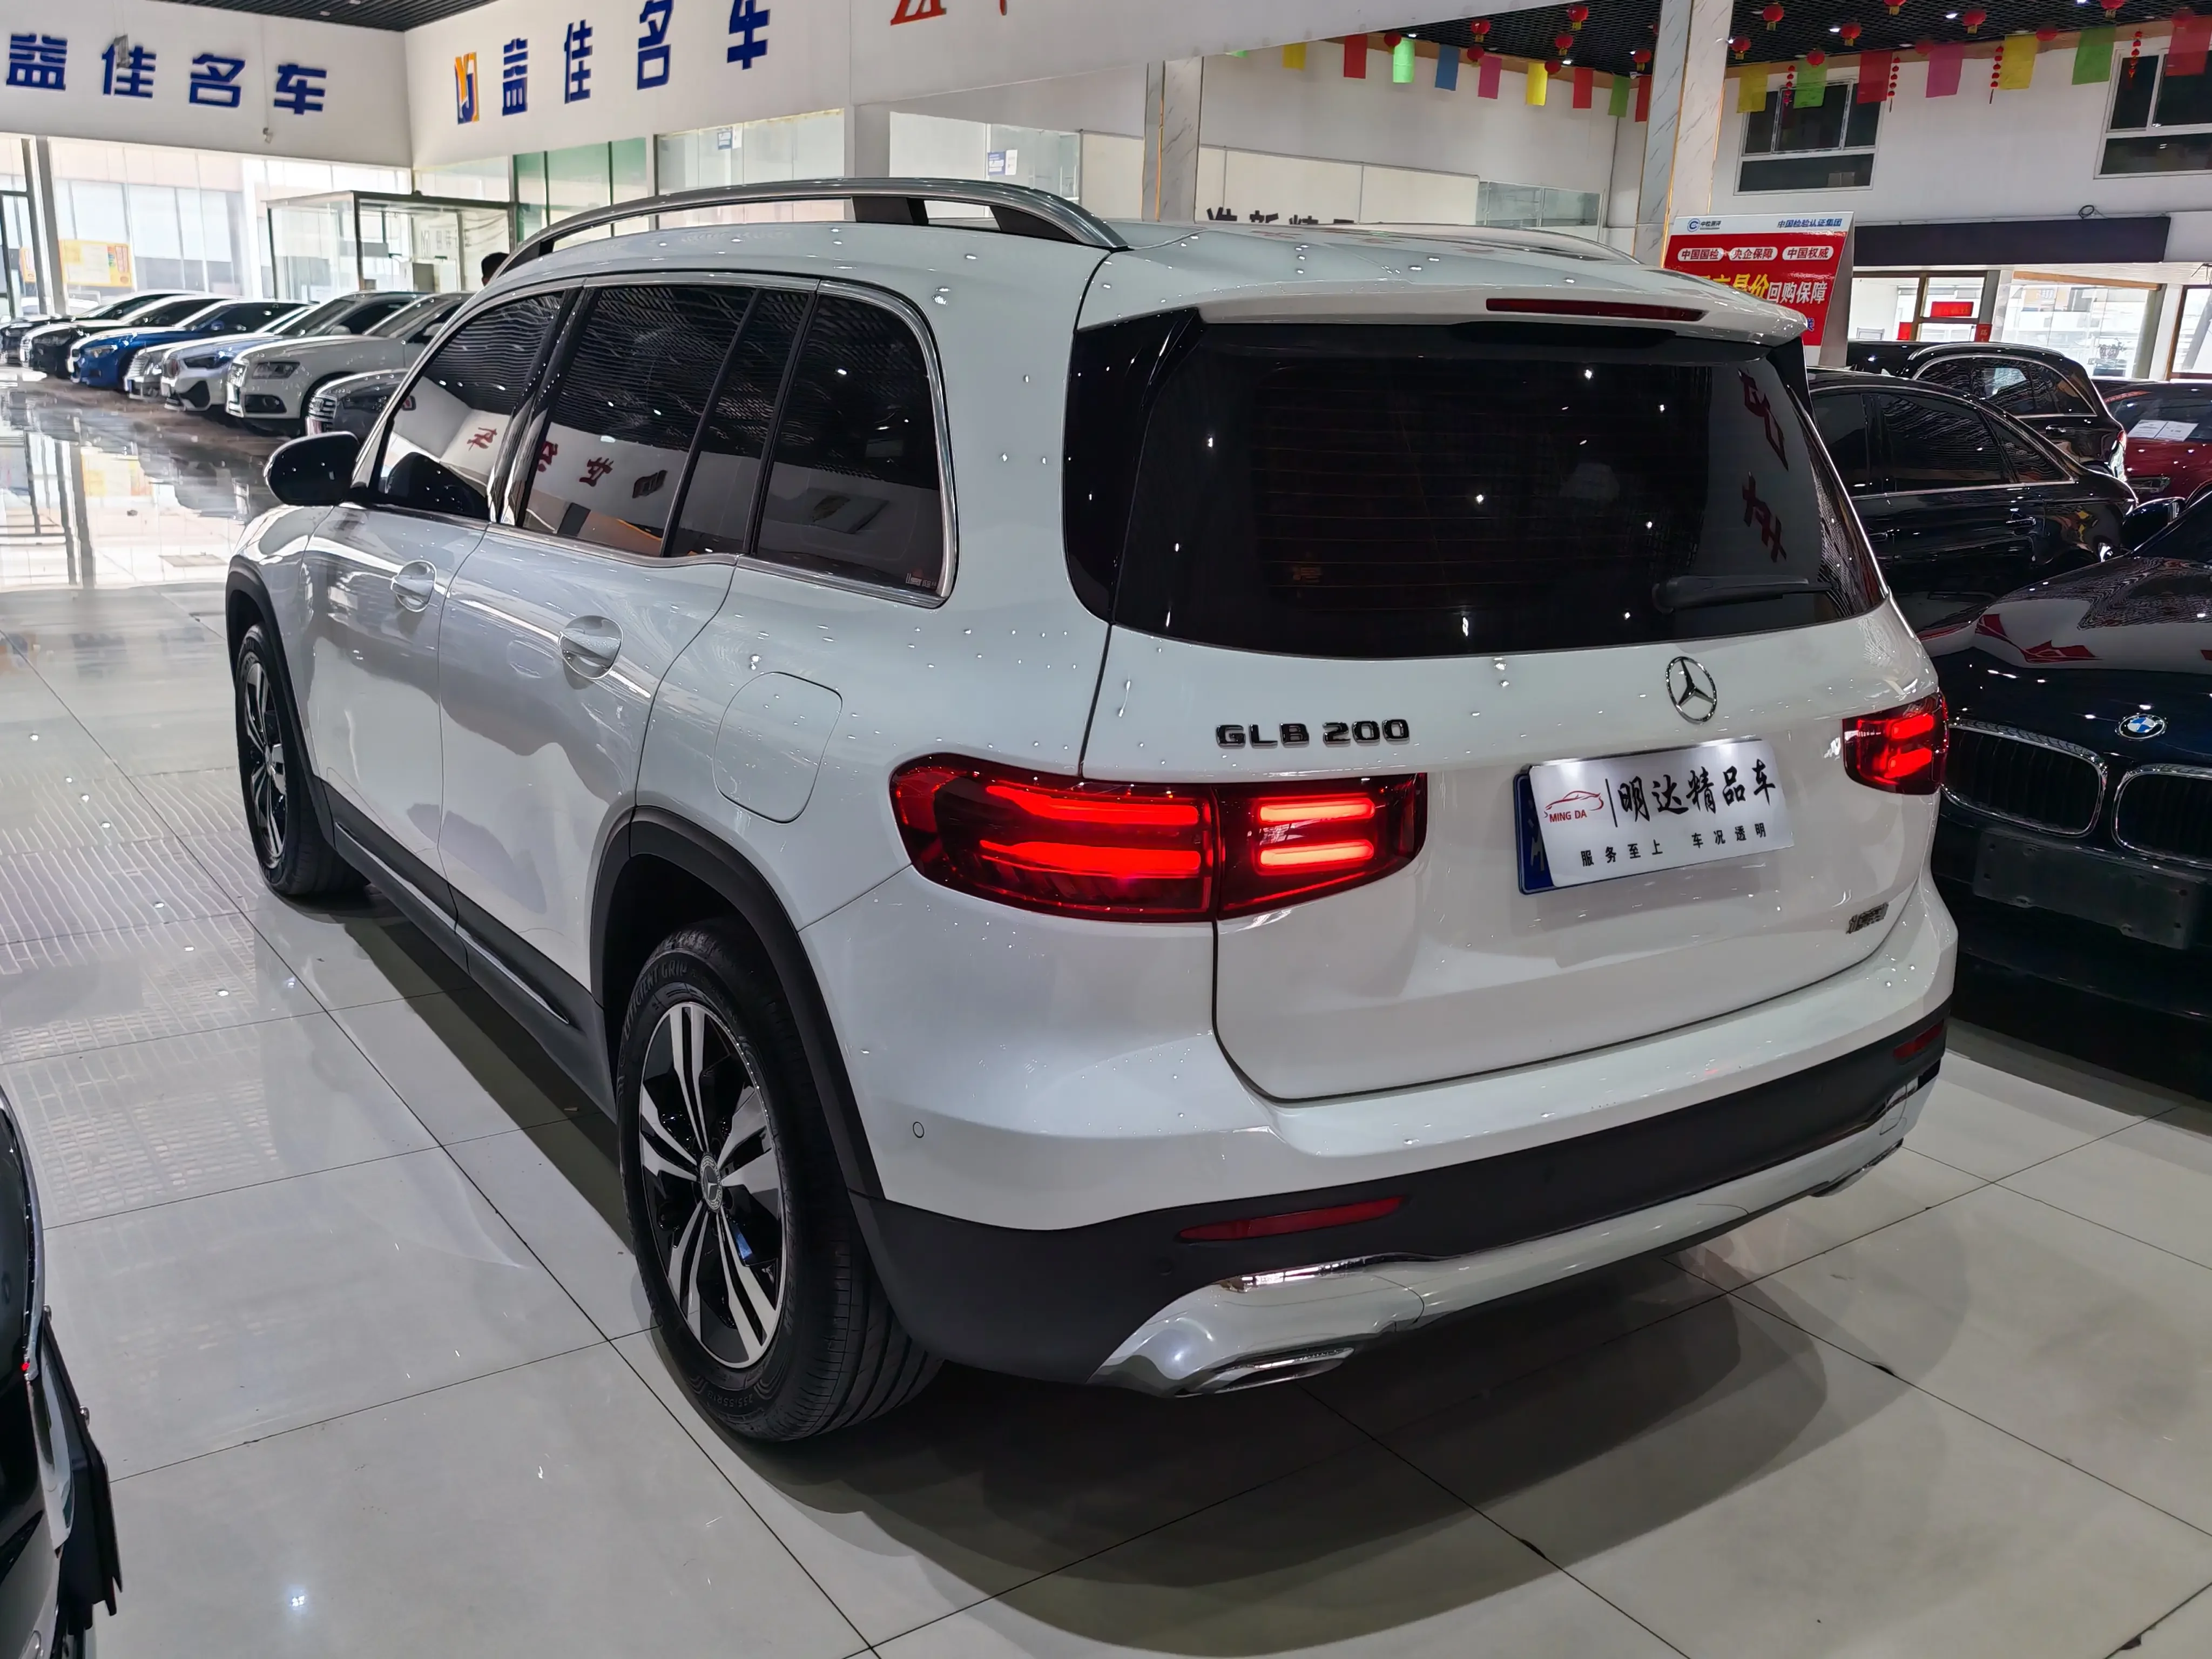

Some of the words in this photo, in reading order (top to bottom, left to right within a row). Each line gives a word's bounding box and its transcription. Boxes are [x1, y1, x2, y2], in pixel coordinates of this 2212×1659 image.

[5, 32, 328, 116] 益佳名车
[501, 0, 771, 117] 益佳名车
[1777, 218, 1843, 228] 中国检验认证集团
[1681, 248, 1718, 260] 中国国检
[1731, 247, 1774, 260] 央企保障
[1786, 246, 1830, 259] 中国权威
[1216, 723, 1310, 748] GLB
[1322, 718, 1411, 747] 200
[1617, 759, 1776, 822] 明达精品车
[1548, 810, 1572, 823] MING
[1574, 808, 1588, 820] DA
[1580, 839, 1663, 867] 服务至上
[1691, 822, 1768, 849] 车况透明
